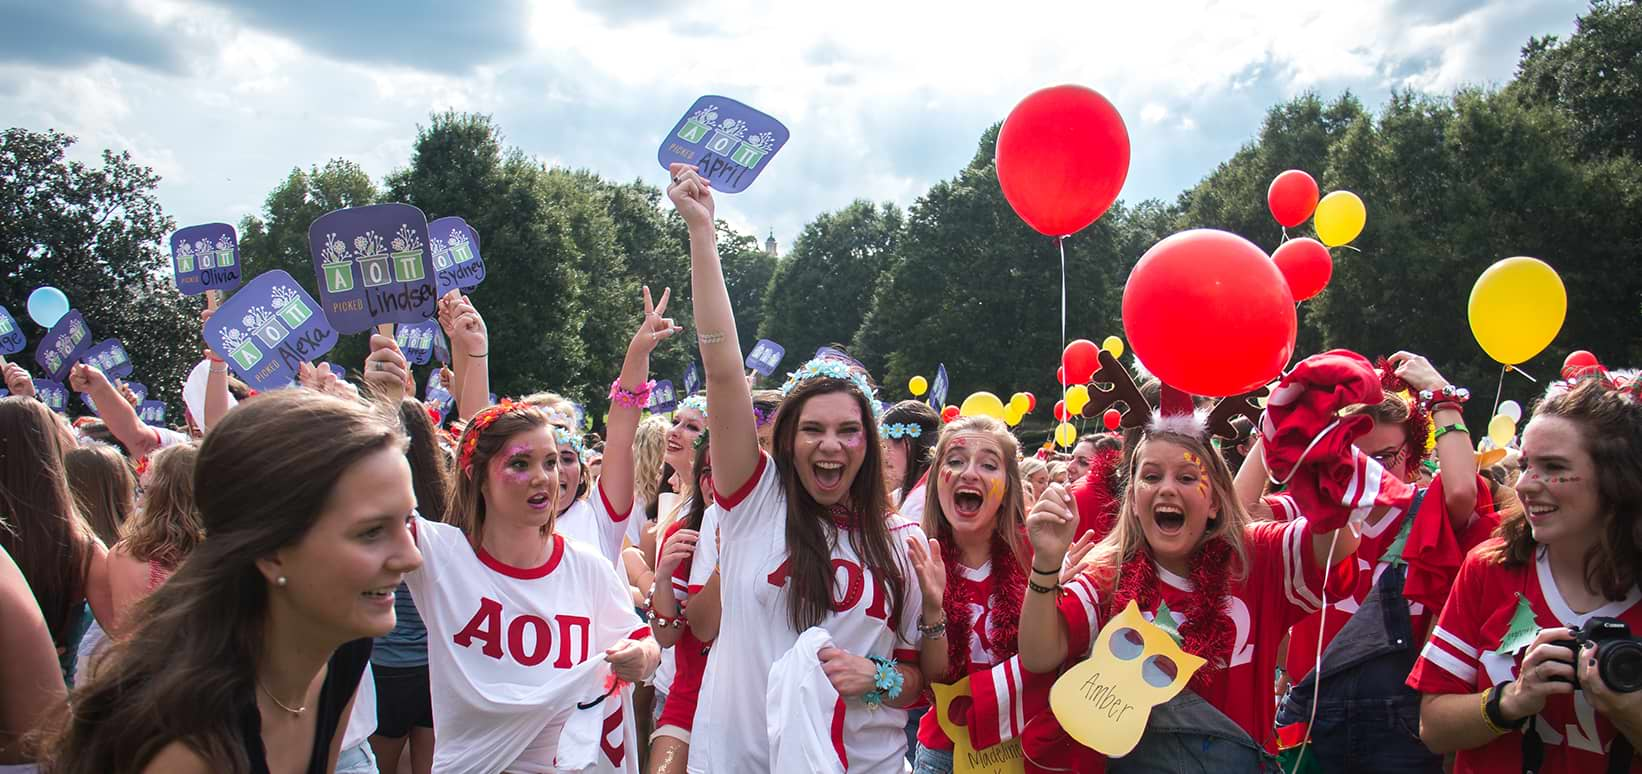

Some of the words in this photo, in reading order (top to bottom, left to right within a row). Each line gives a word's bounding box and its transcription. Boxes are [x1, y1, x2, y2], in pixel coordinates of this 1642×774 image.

[697, 152, 749, 188] April
[200, 270, 239, 286] Olivia
[438, 260, 483, 287] Sydney
[333, 299, 364, 313] PICKED
[365, 283, 437, 318] Lindsey
[278, 328, 330, 370] Alexa
[255, 358, 281, 383] PICKED
[1080, 672, 1135, 723] Amber
